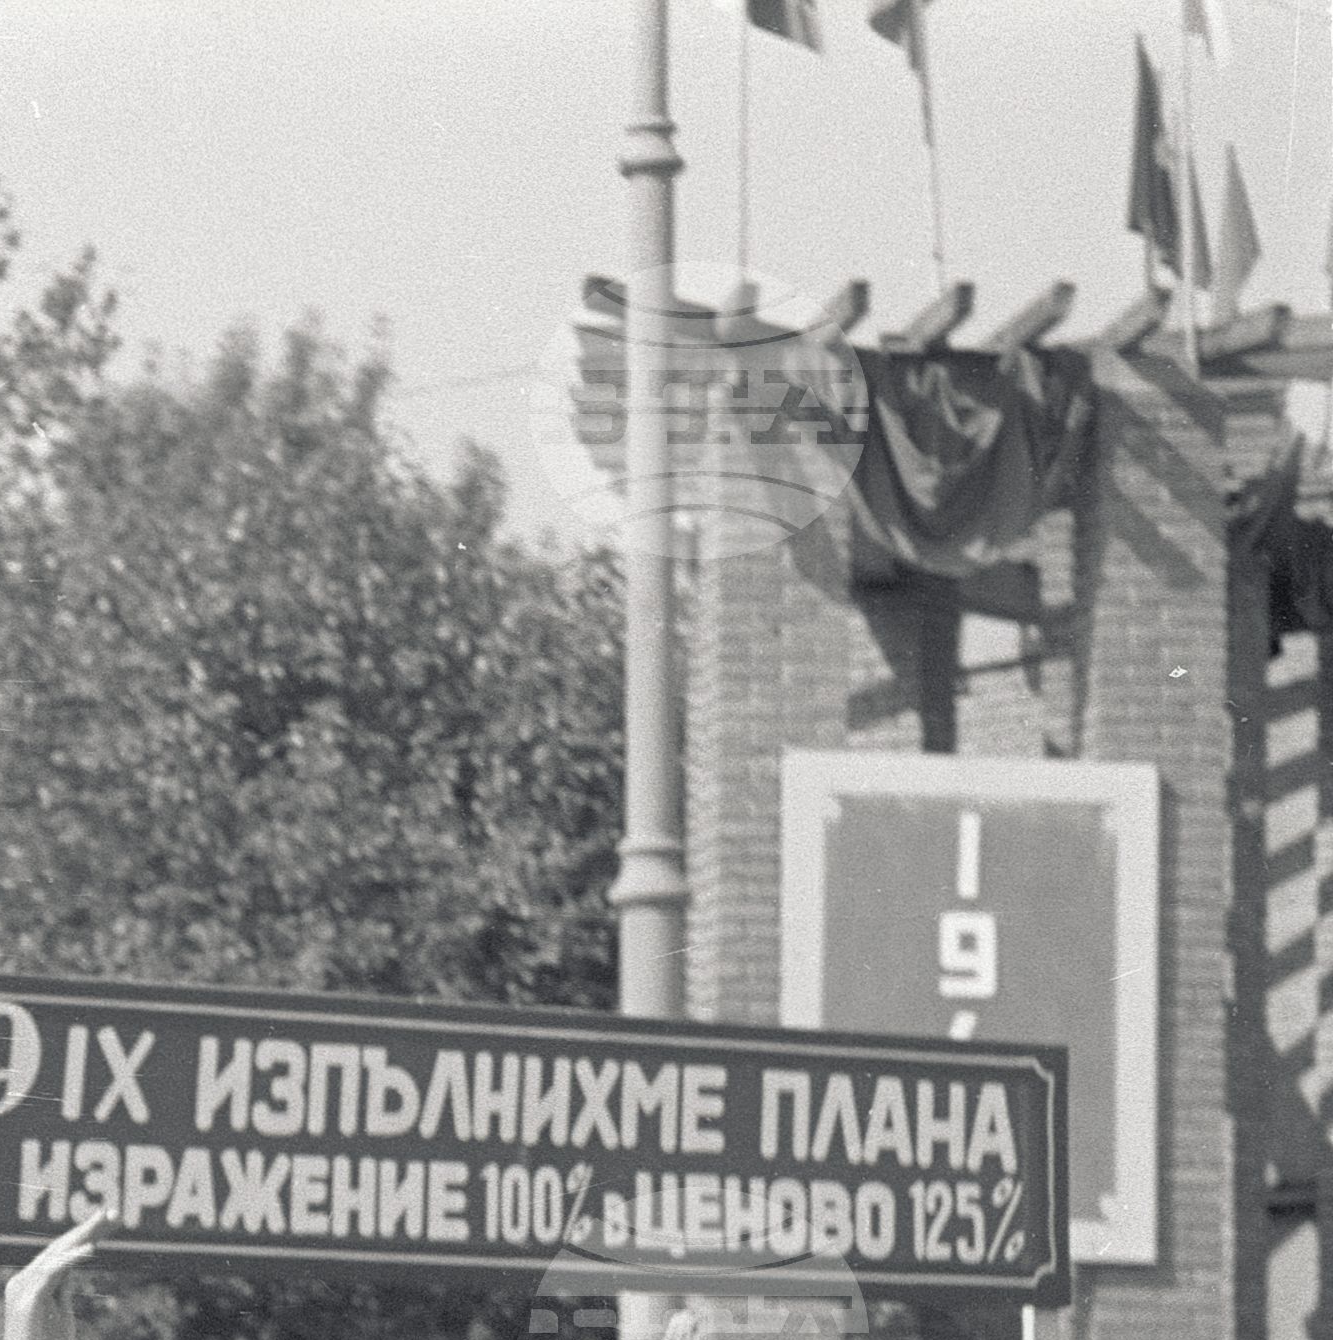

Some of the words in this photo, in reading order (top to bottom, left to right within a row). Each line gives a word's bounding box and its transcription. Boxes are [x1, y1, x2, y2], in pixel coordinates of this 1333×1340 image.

[194, 1036, 728, 1154] ИЗПЪЛНИХМЕ
[759, 1069, 1017, 1173] ПЛАНА
[17, 1139, 470, 1241] ИЗРАЖЕНИЕ
[480, 1162, 593, 1245] 100%
[633, 1171, 896, 1259] ЦЕНОВО
[908, 1175, 1025, 1264] 125%
